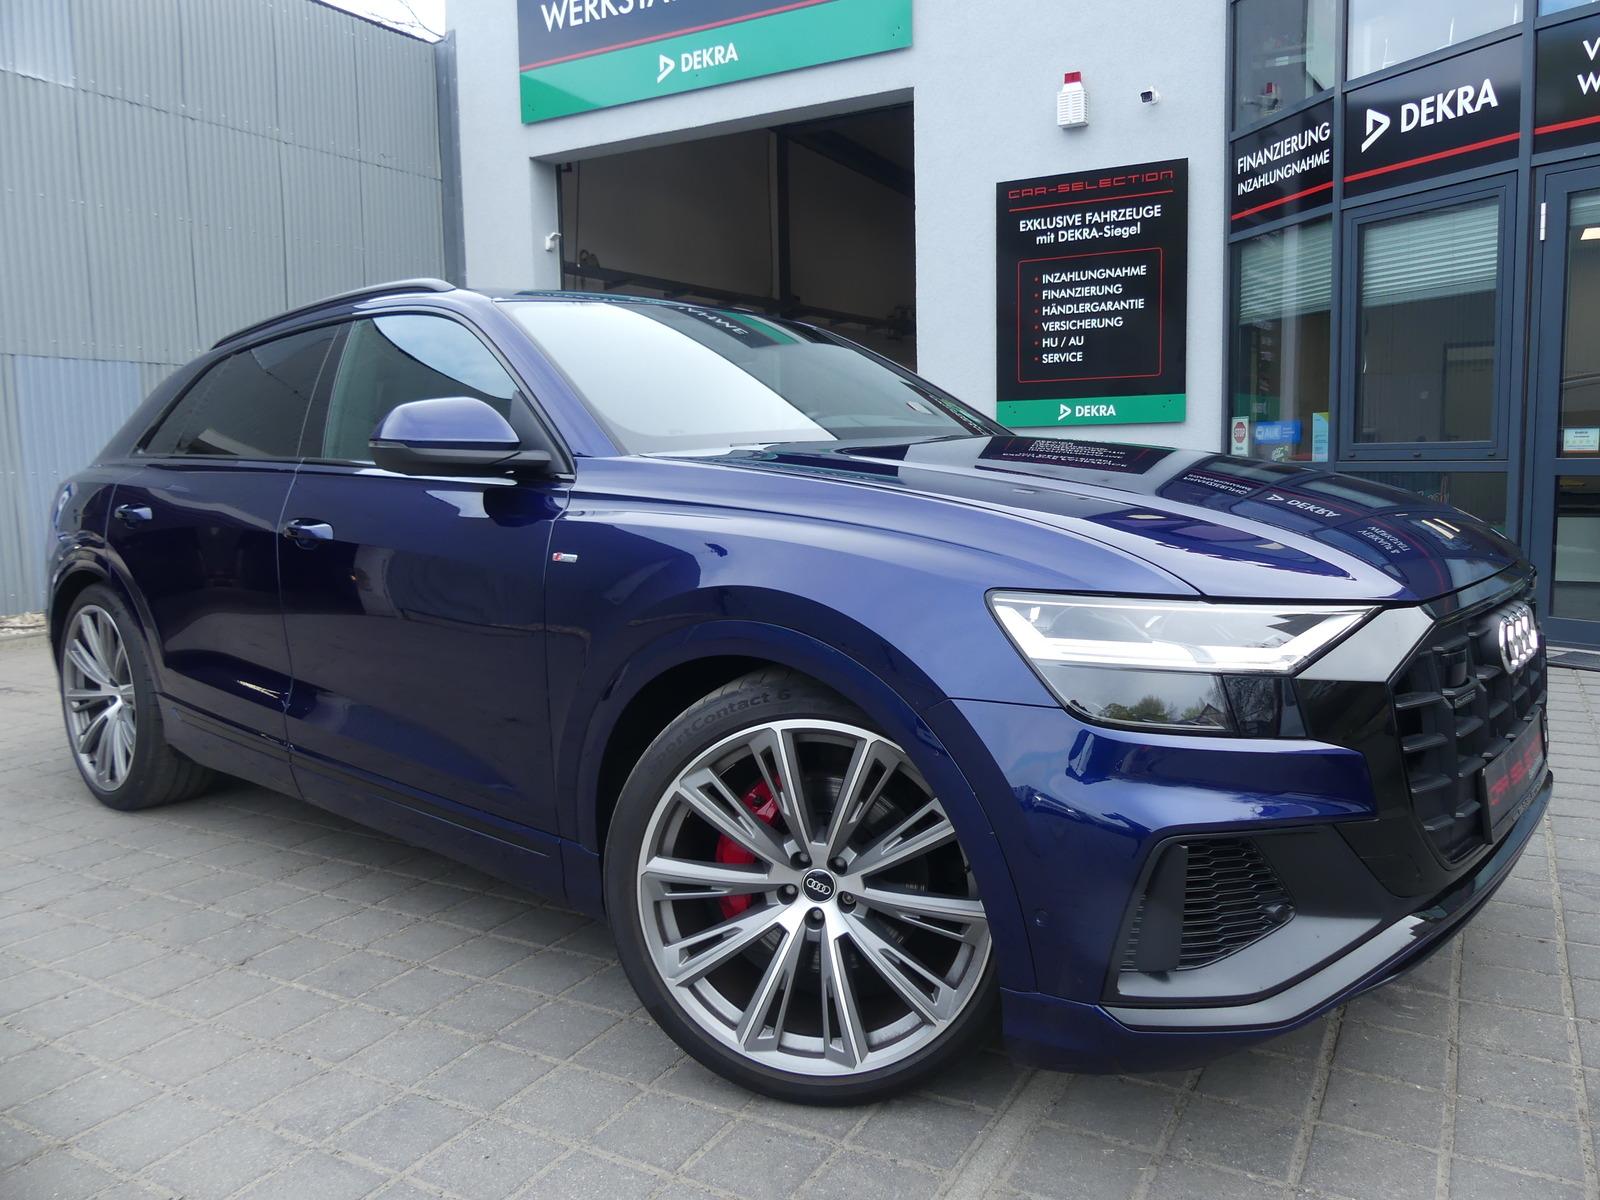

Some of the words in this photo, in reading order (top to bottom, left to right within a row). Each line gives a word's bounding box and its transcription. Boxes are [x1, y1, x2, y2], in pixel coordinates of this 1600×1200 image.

[680, 42, 739, 73] DEKRA
[1400, 78, 1498, 133] DEKRA
[1237, 122, 1331, 175] FINANZIERUNG
[1237, 149, 1330, 196] INZAHLUNGNAHME
[1008, 170, 1174, 199] CAR-SELECTION
[1019, 213, 1082, 232] EXKLUSIVE
[1085, 204, 1162, 225] FAHRZEUGE
[1036, 232, 1055, 245] mit
[1058, 222, 1141, 243] DEKRA-Siegel
[1042, 265, 1147, 284] INZAHLUNGNAHME
[1042, 284, 1123, 300] FINANZIERUNG
[1042, 298, 1145, 316] HÄNDLERGARANTIE
[1042, 317, 1124, 332] VERSICHERUNG
[1042, 338, 1058, 348] HU
[1068, 336, 1084, 347] AU
[1042, 352, 1083, 364] SERVICE
[1075, 404, 1116, 417] DEKRA
